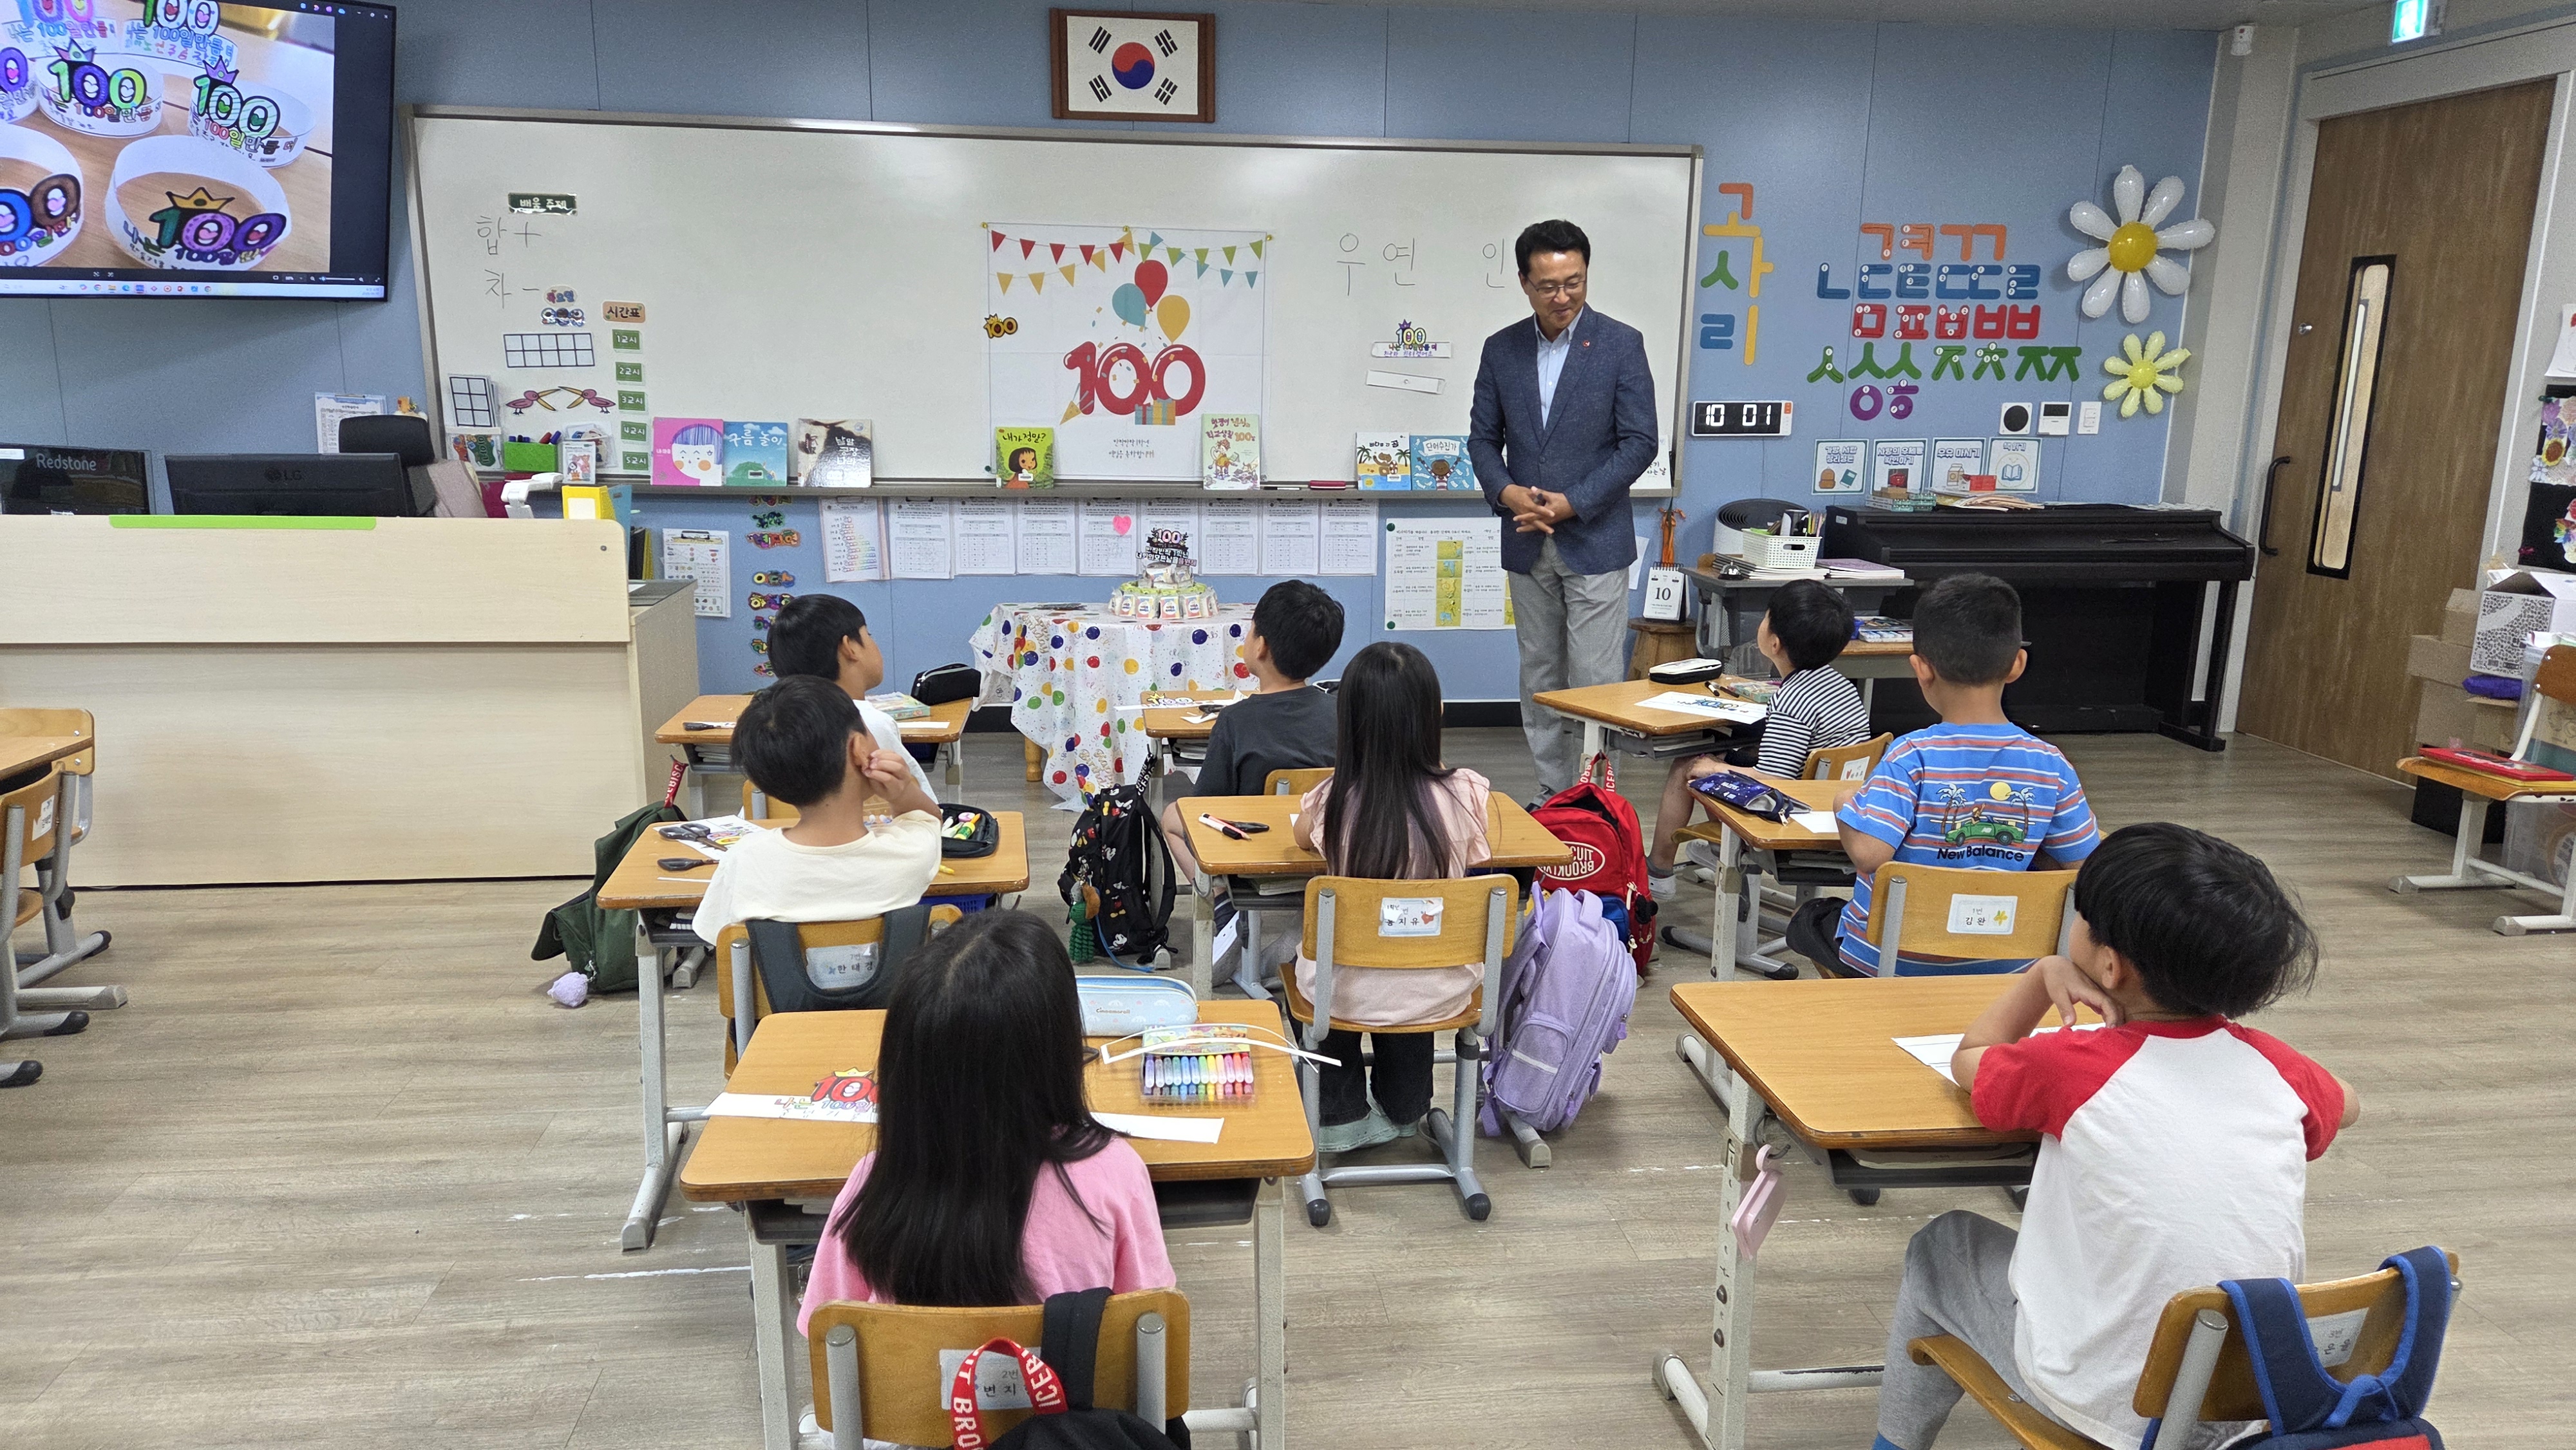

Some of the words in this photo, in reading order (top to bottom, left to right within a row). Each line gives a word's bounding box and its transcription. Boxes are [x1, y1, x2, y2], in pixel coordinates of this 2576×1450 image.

[48, 59, 147, 109] 100
[193, 74, 281, 140] 100
[519, 196, 542, 210] 배움
[149, 206, 287, 250] 100
[477, 216, 507, 255] 합
[484, 268, 512, 308] 차
[607, 305, 641, 319] 시간표
[616, 335, 638, 344] 1교시
[1395, 327, 1426, 346] 100
[619, 366, 640, 376] 2교시
[1063, 341, 1206, 417] 100
[621, 397, 643, 405] 3교시
[1743, 404, 1771, 426] 01
[623, 427, 645, 436] 4교시
[728, 429, 755, 447] 구름
[759, 431, 784, 447] 놀이
[1937, 447, 1955, 458] 우유
[36, 453, 97, 472] Redstone
[626, 457, 647, 465] 5교시
[283, 470, 303, 482] LG
[1156, 528, 1182, 544] 100
[1655, 587, 1672, 601] 10
[1937, 847, 1965, 860] New
[1966, 844, 2025, 862] Balance
[1001, 1369, 1019, 1380] 2번
